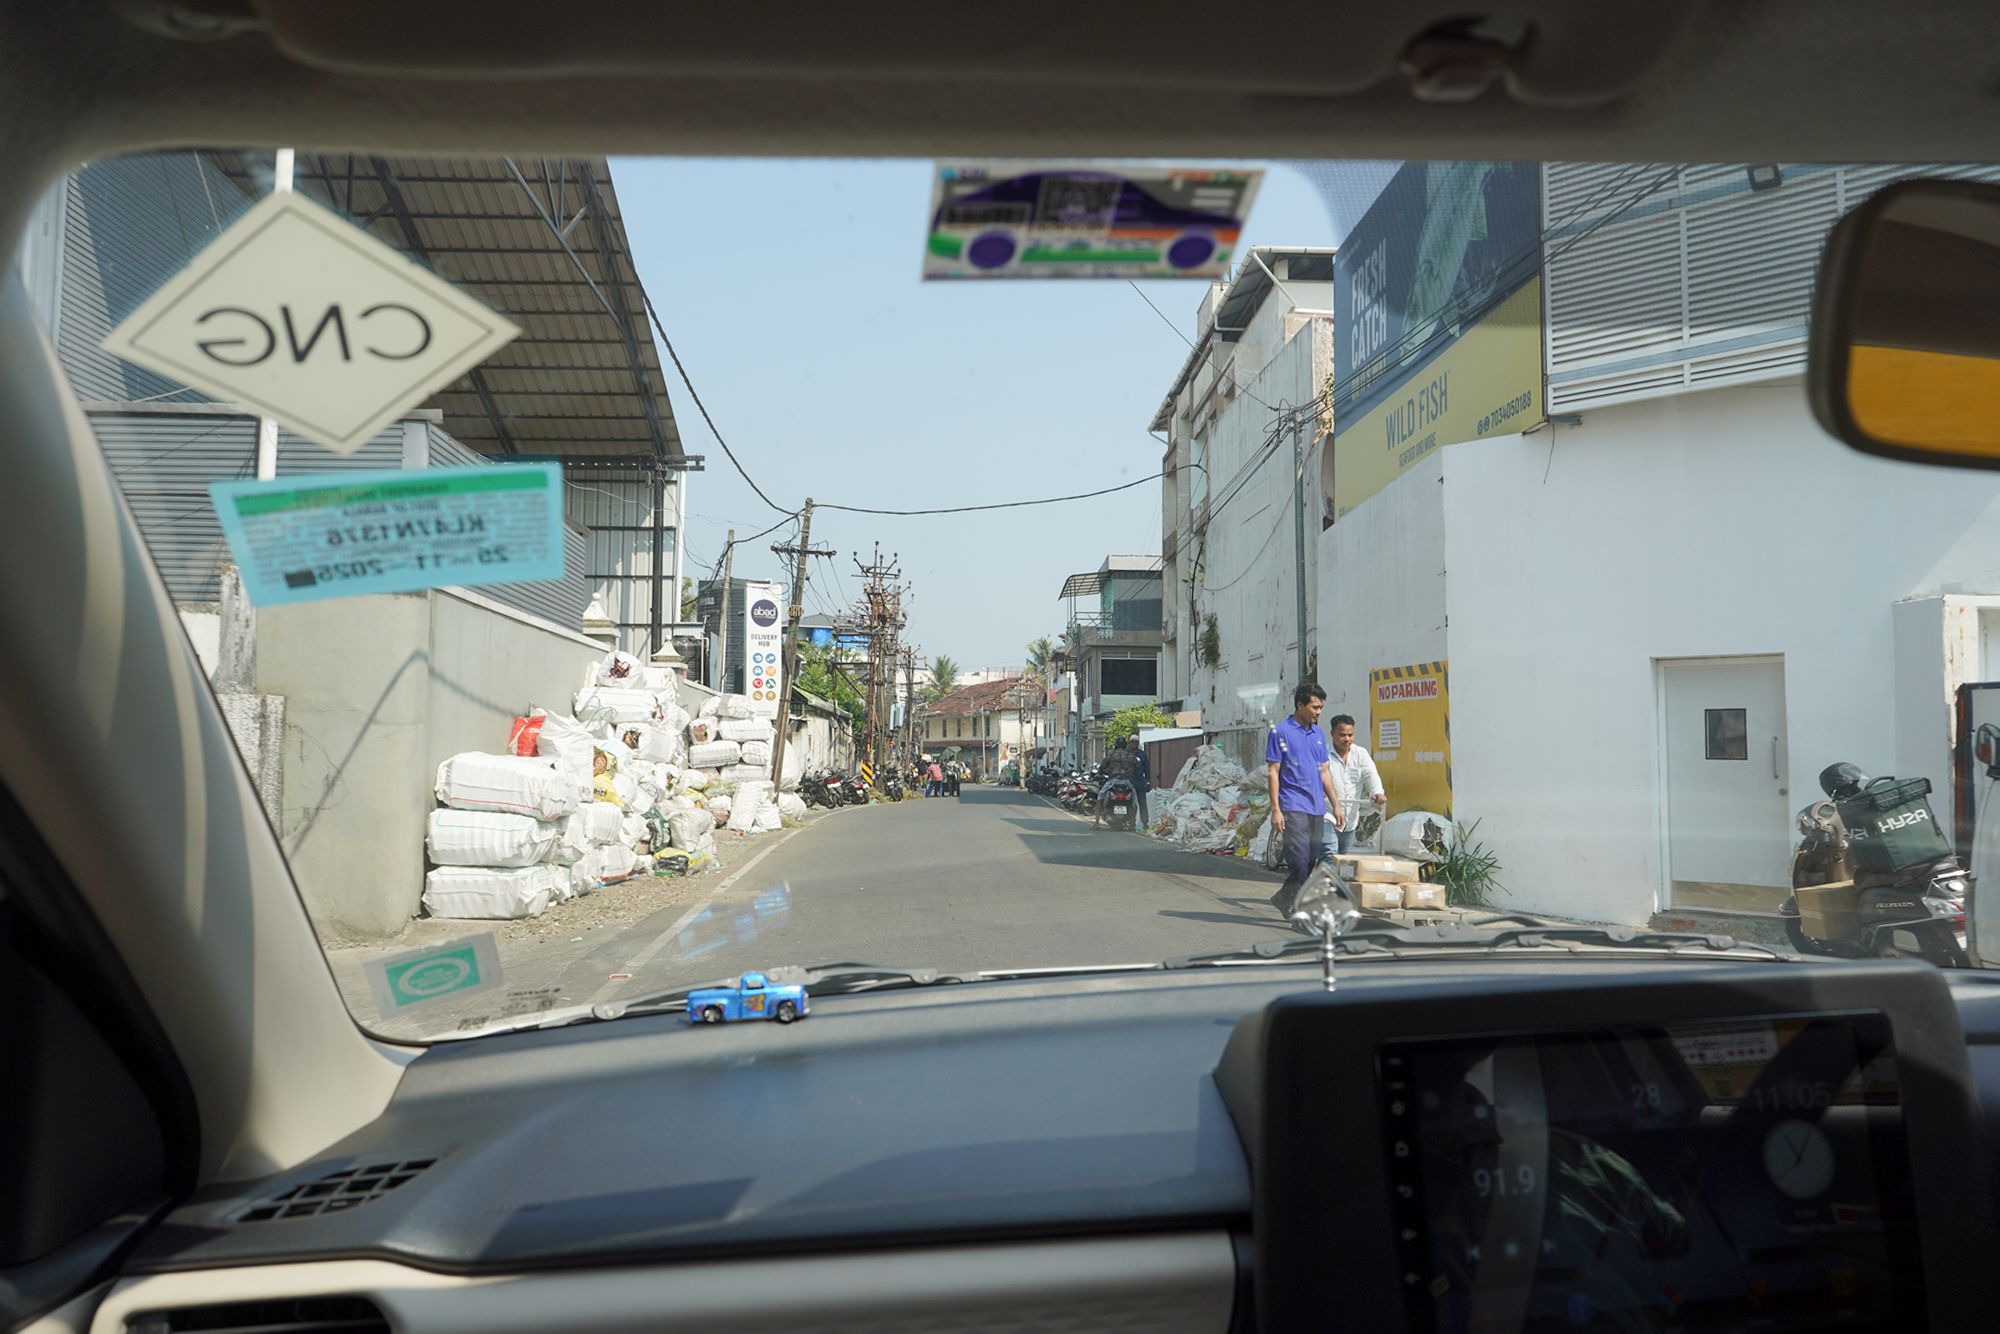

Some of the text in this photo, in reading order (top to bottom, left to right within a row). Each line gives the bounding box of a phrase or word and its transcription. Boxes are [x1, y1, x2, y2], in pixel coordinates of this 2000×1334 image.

[1352, 238, 1387, 320] FRESH
[1352, 294, 1387, 370] CATCH
[1385, 397, 1415, 451] WILD
[1419, 373, 1448, 430] FISH
[753, 606, 777, 618] abad
[751, 633, 777, 641] DELIVERY
[758, 640, 770, 648] HUB
[1378, 680, 1437, 701] NO PARKING
[1876, 808, 1929, 834] HYZA
[1630, 1082, 1661, 1110] 28
[1472, 1164, 1537, 1199] 91.9
